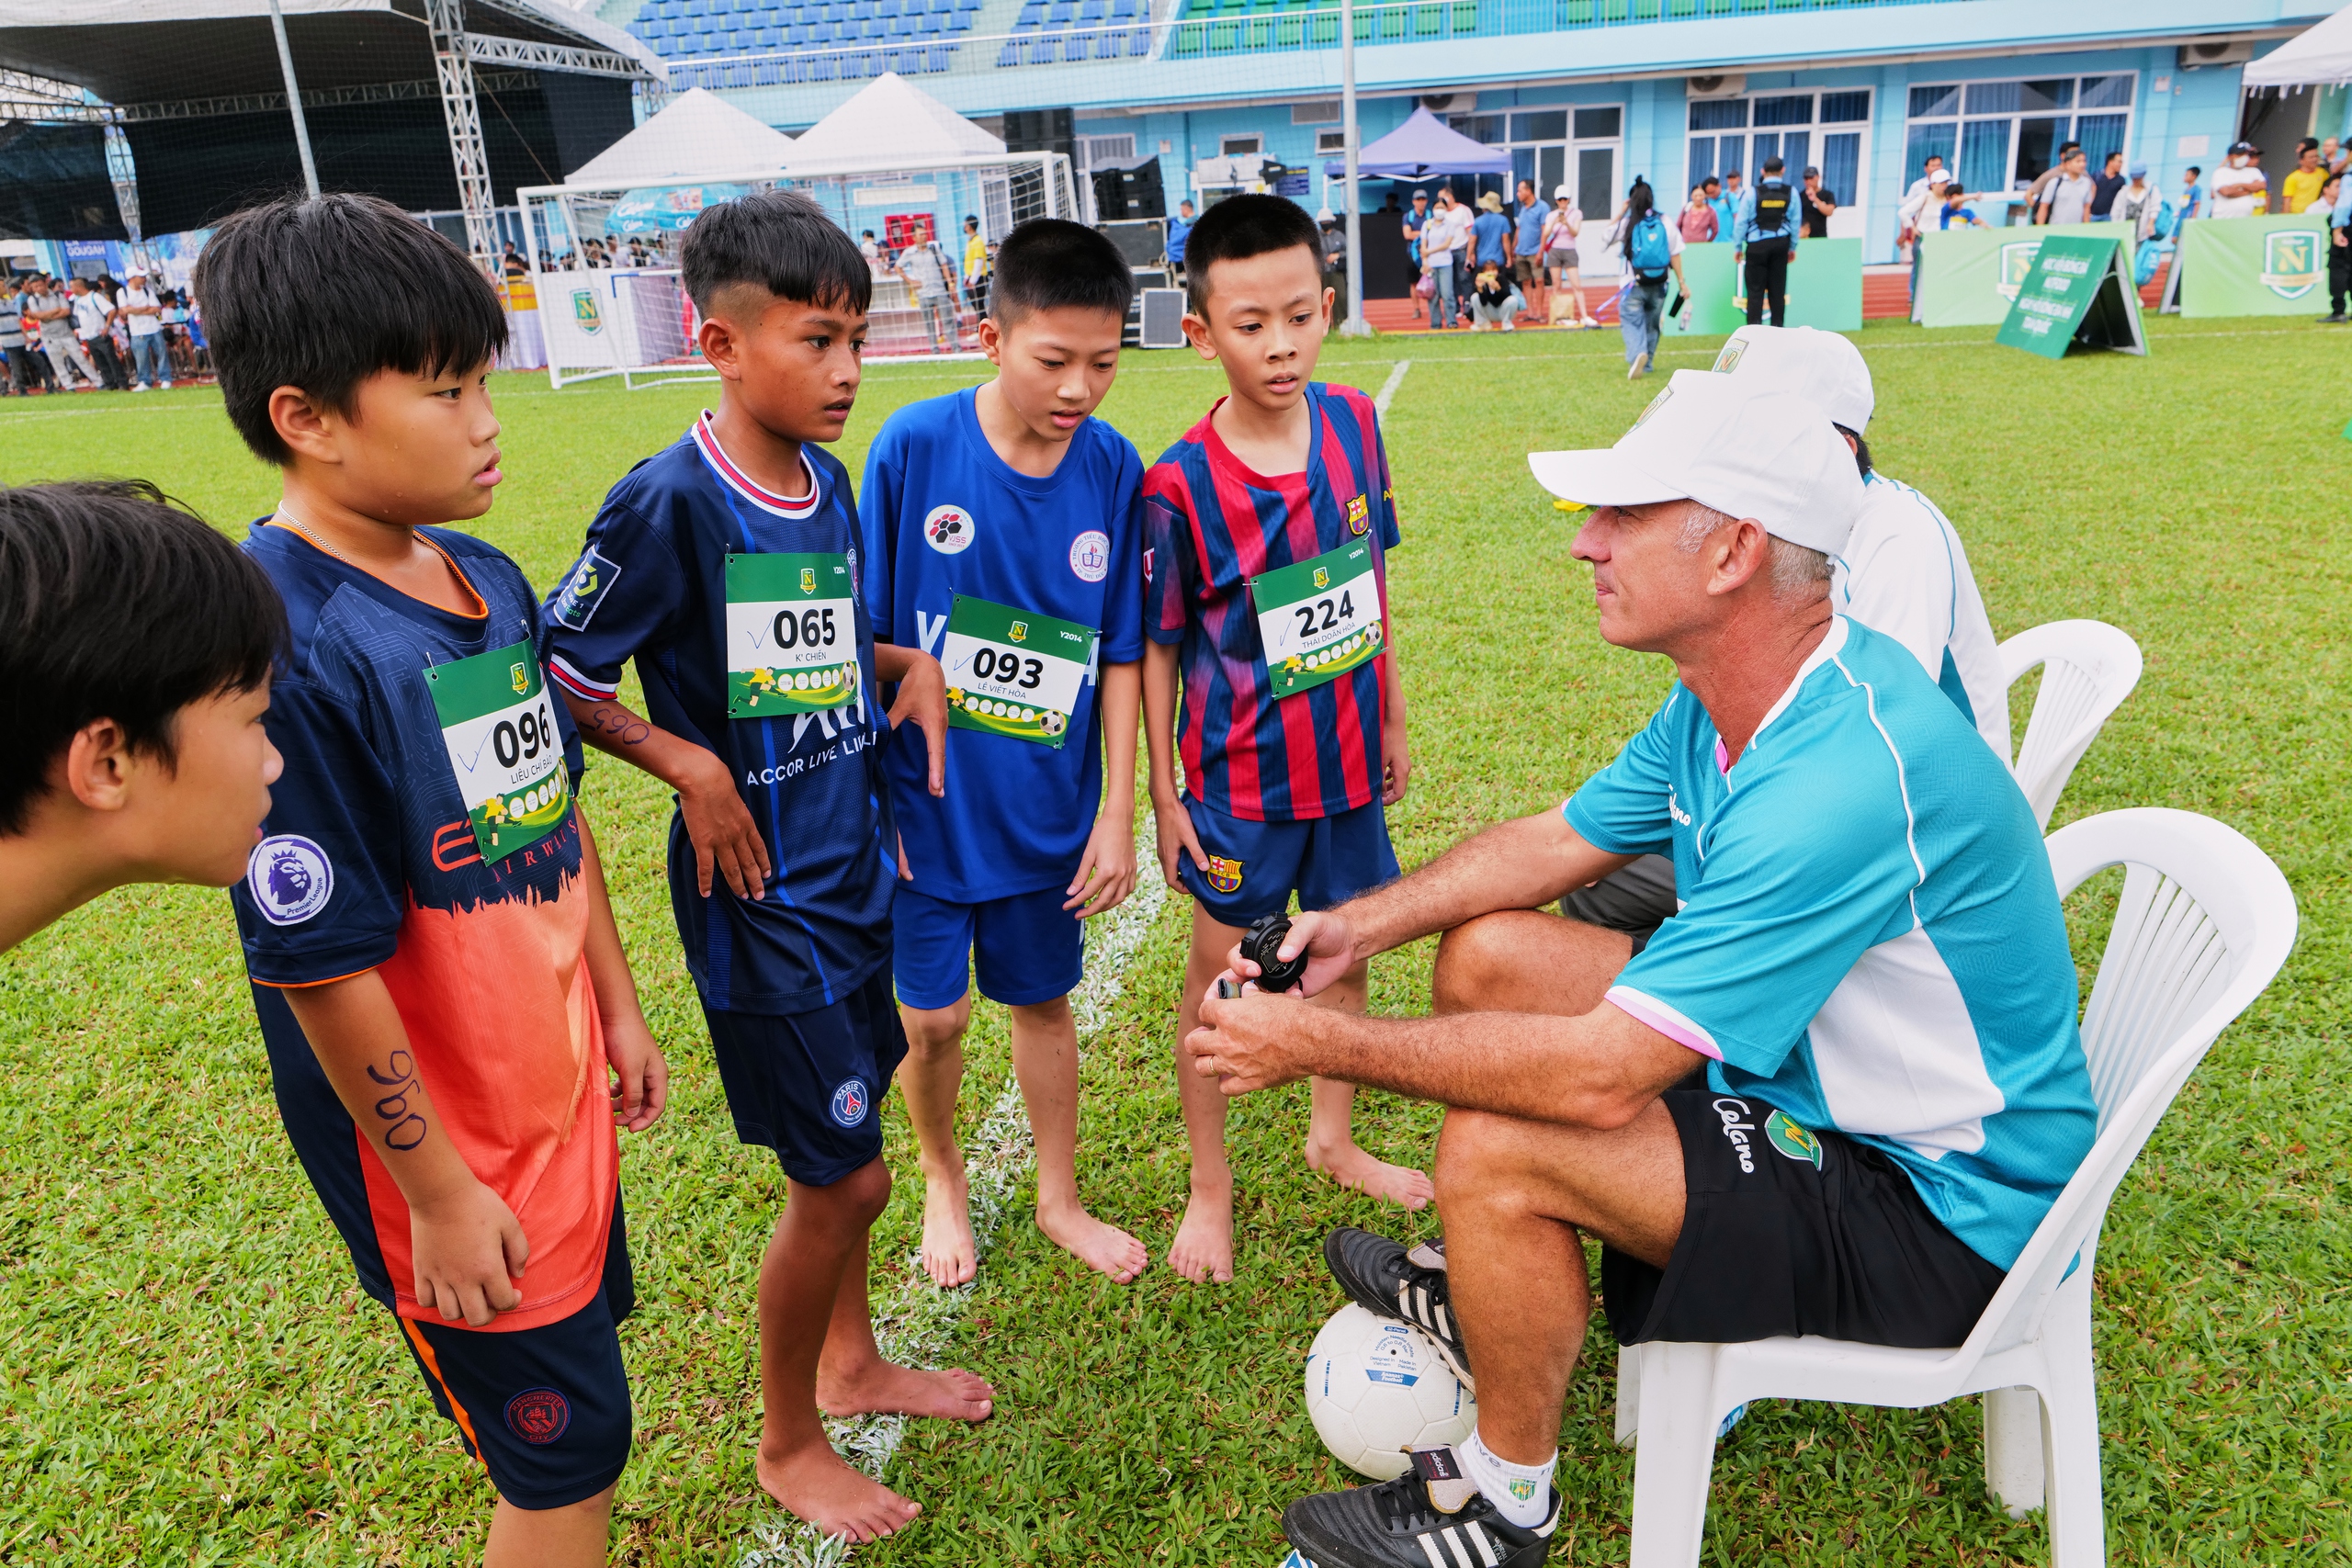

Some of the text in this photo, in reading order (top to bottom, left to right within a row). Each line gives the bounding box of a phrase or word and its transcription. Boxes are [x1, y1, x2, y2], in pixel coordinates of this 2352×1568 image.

[774, 608, 836, 649] 065
[1295, 590, 1354, 637] 224
[1059, 630, 1082, 643] Y2014
[1302, 637, 1320, 649] THÁI
[1322, 629, 1341, 642] DOÃN
[806, 649, 827, 661] CHIẾN
[973, 648, 1044, 689] 093
[989, 683, 1007, 695] VIẾT
[493, 703, 550, 768] 096
[511, 768, 530, 784] LIÊU
[747, 745, 837, 786] ACCOR LIVE
[287, 877, 323, 915] Premier League
[837, 1083, 859, 1100] PARIS
[1712, 1098, 1755, 1173] Celano
[1430, 1451, 1445, 1477] adidas
